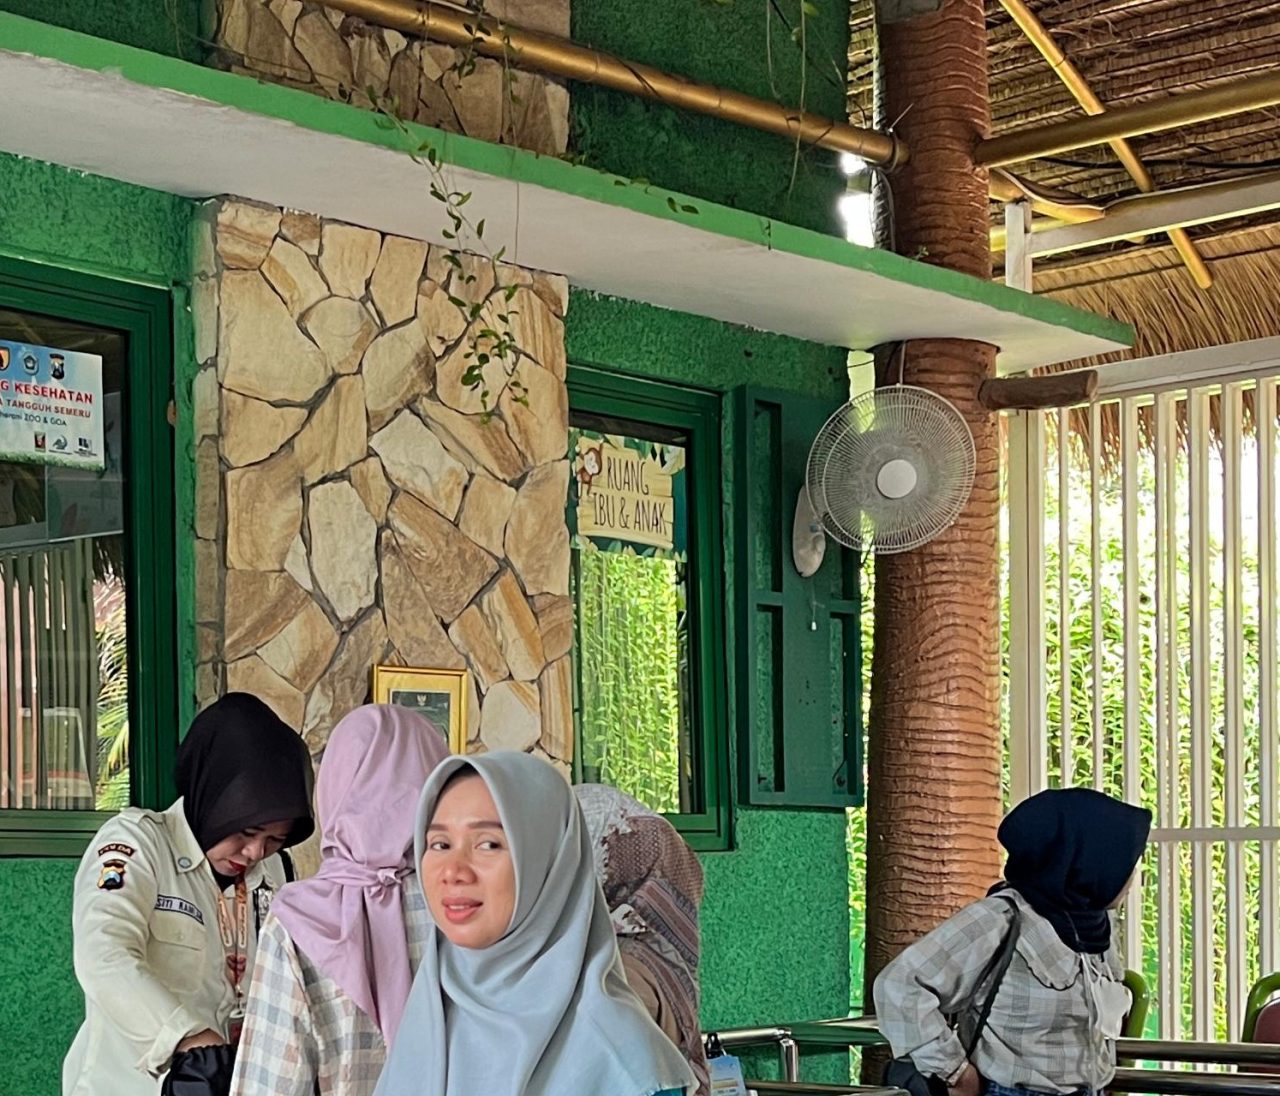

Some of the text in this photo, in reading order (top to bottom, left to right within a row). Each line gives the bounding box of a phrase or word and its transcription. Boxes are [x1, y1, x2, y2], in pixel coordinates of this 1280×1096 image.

[14, 382, 94, 404] KESEHATAN
[7, 399, 52, 413] TANGGUH
[54, 405, 91, 418] SEMERU
[24, 413, 41, 424] ZOO
[50, 417, 67, 427] GOA
[607, 456, 650, 496] RUANG
[593, 492, 667, 536] IBU & ANAK
